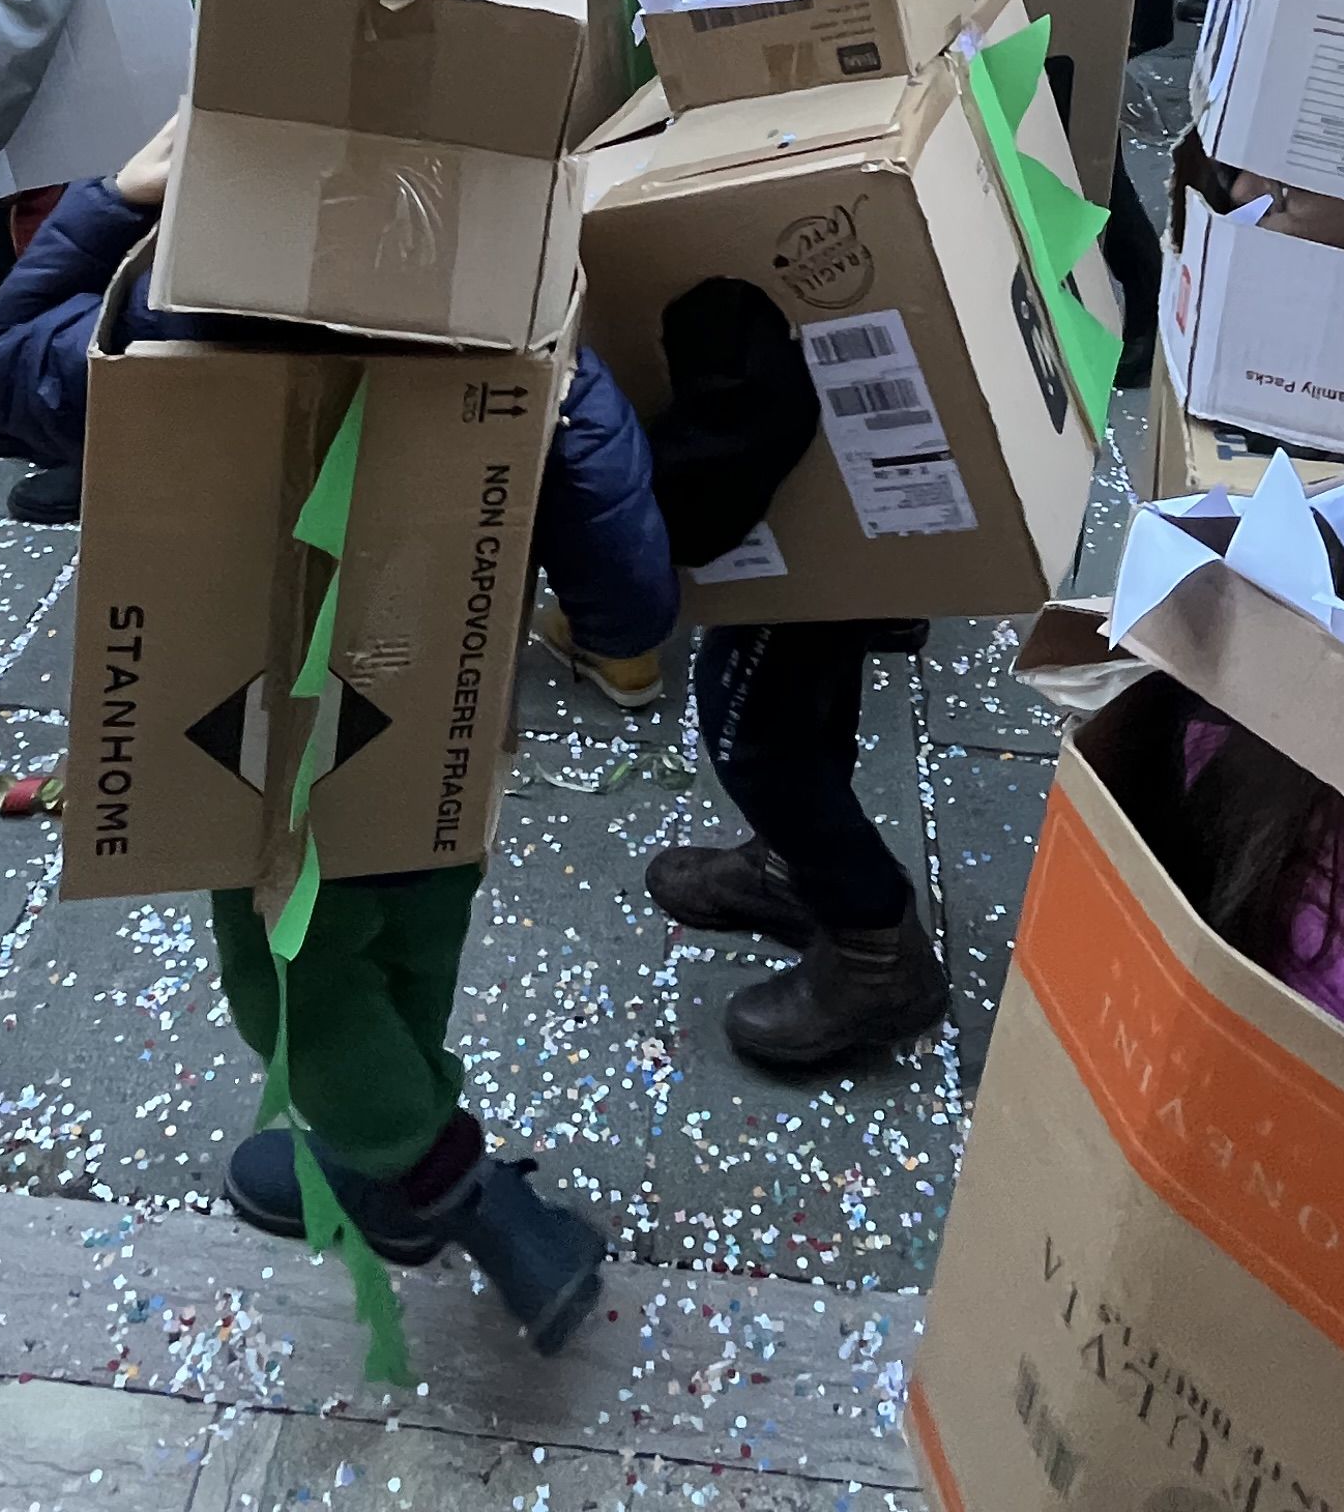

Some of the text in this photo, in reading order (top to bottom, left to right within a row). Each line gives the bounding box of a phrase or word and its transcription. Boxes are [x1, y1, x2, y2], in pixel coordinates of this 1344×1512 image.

[1245, 370, 1296, 394] Packs
[95, 604, 146, 857] STANHOME
[432, 463, 512, 854] NON CAPOVOLGERE FRAGILE
